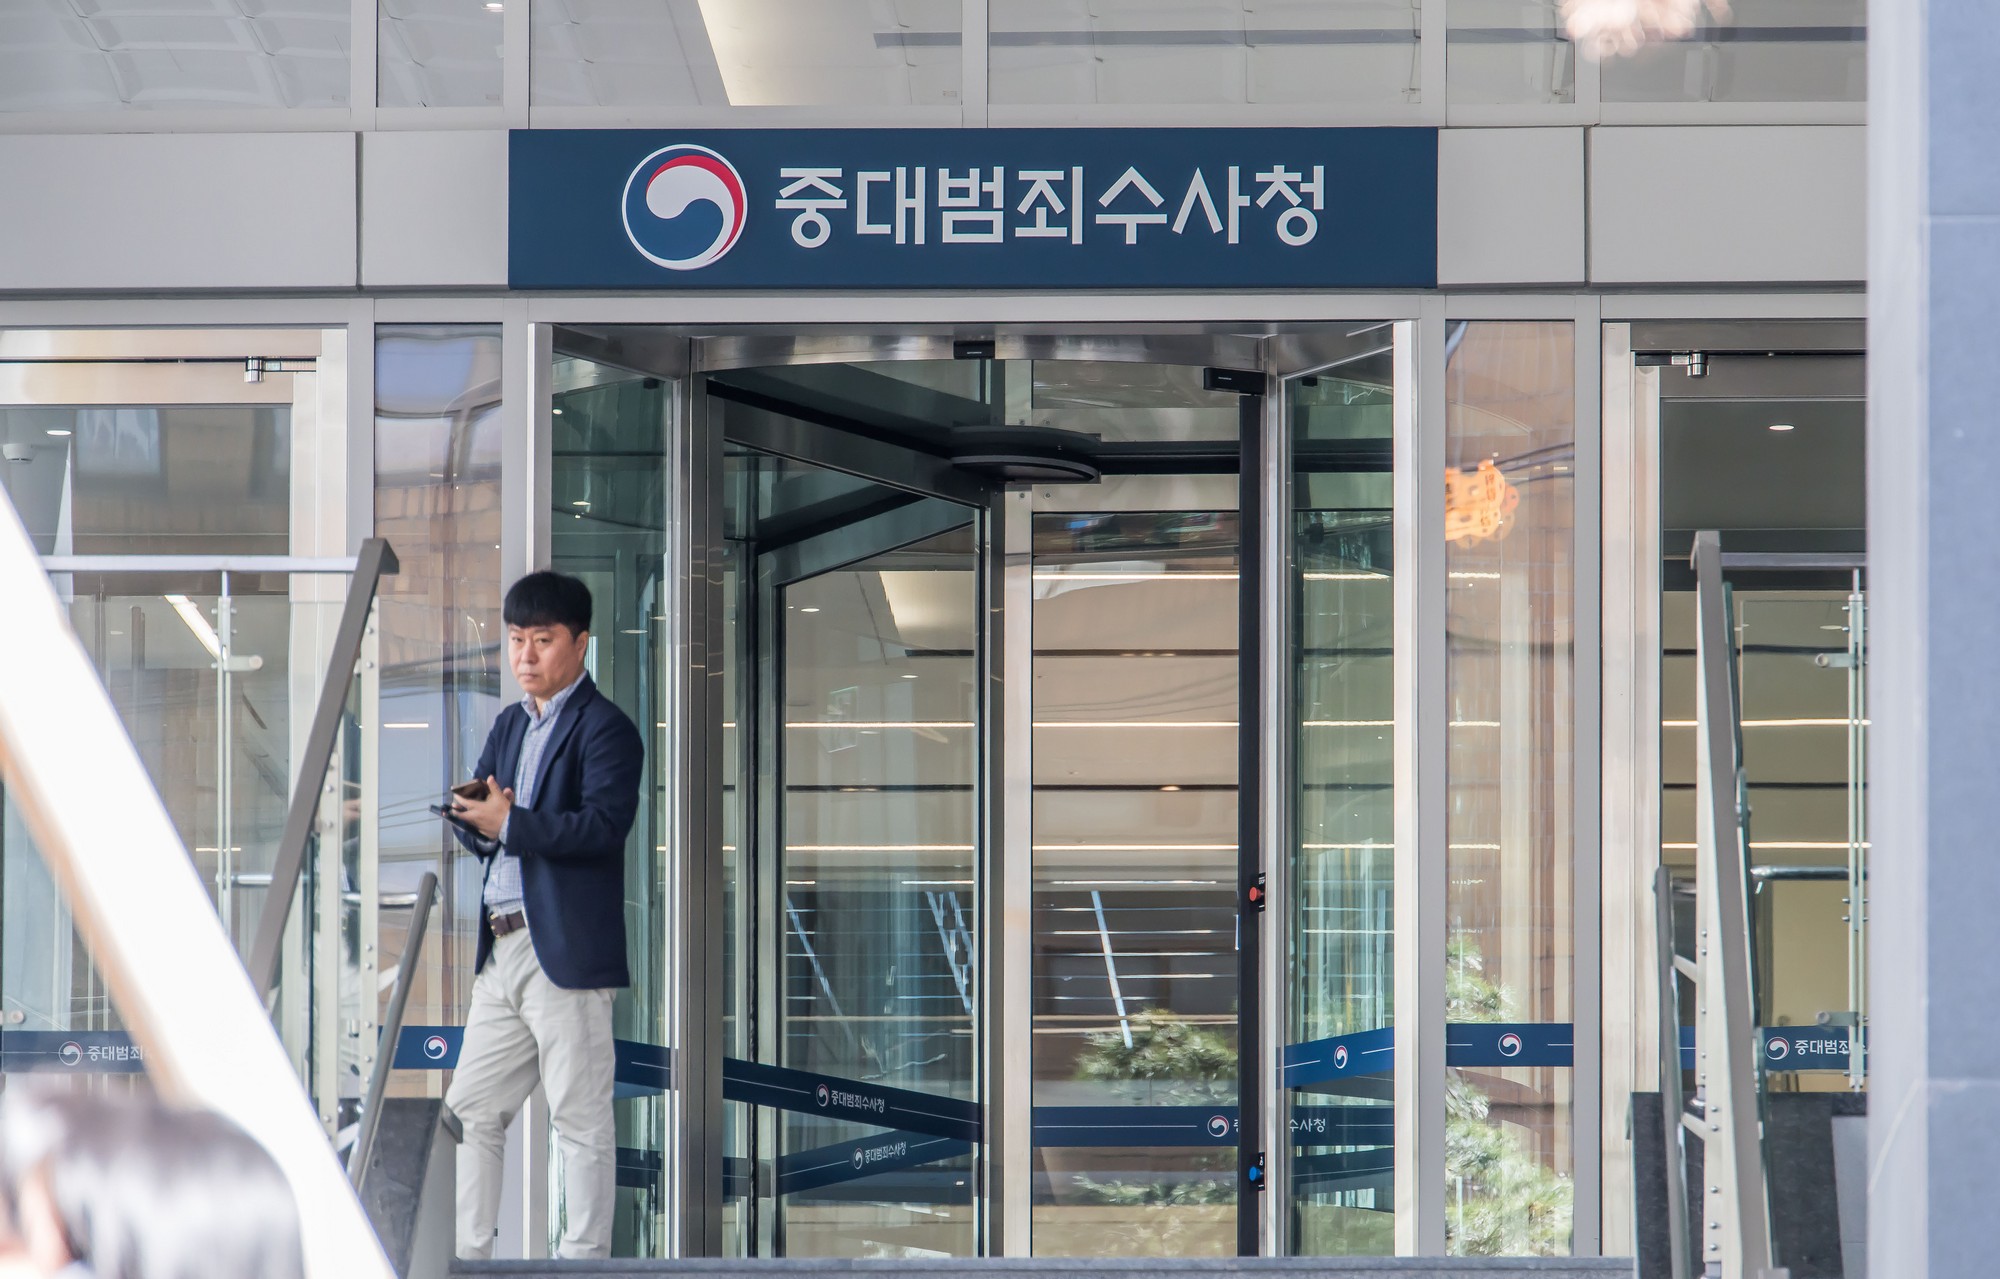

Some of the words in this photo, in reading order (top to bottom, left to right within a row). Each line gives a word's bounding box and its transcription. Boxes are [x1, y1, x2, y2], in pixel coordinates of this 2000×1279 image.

[776, 165, 1325, 248] 중대범죄수사청
[87, 1045, 144, 1061] 중대범죄
[831, 1090, 885, 1113] 중대범죄수사청
[865, 1141, 907, 1164] 중대범죄수사청
